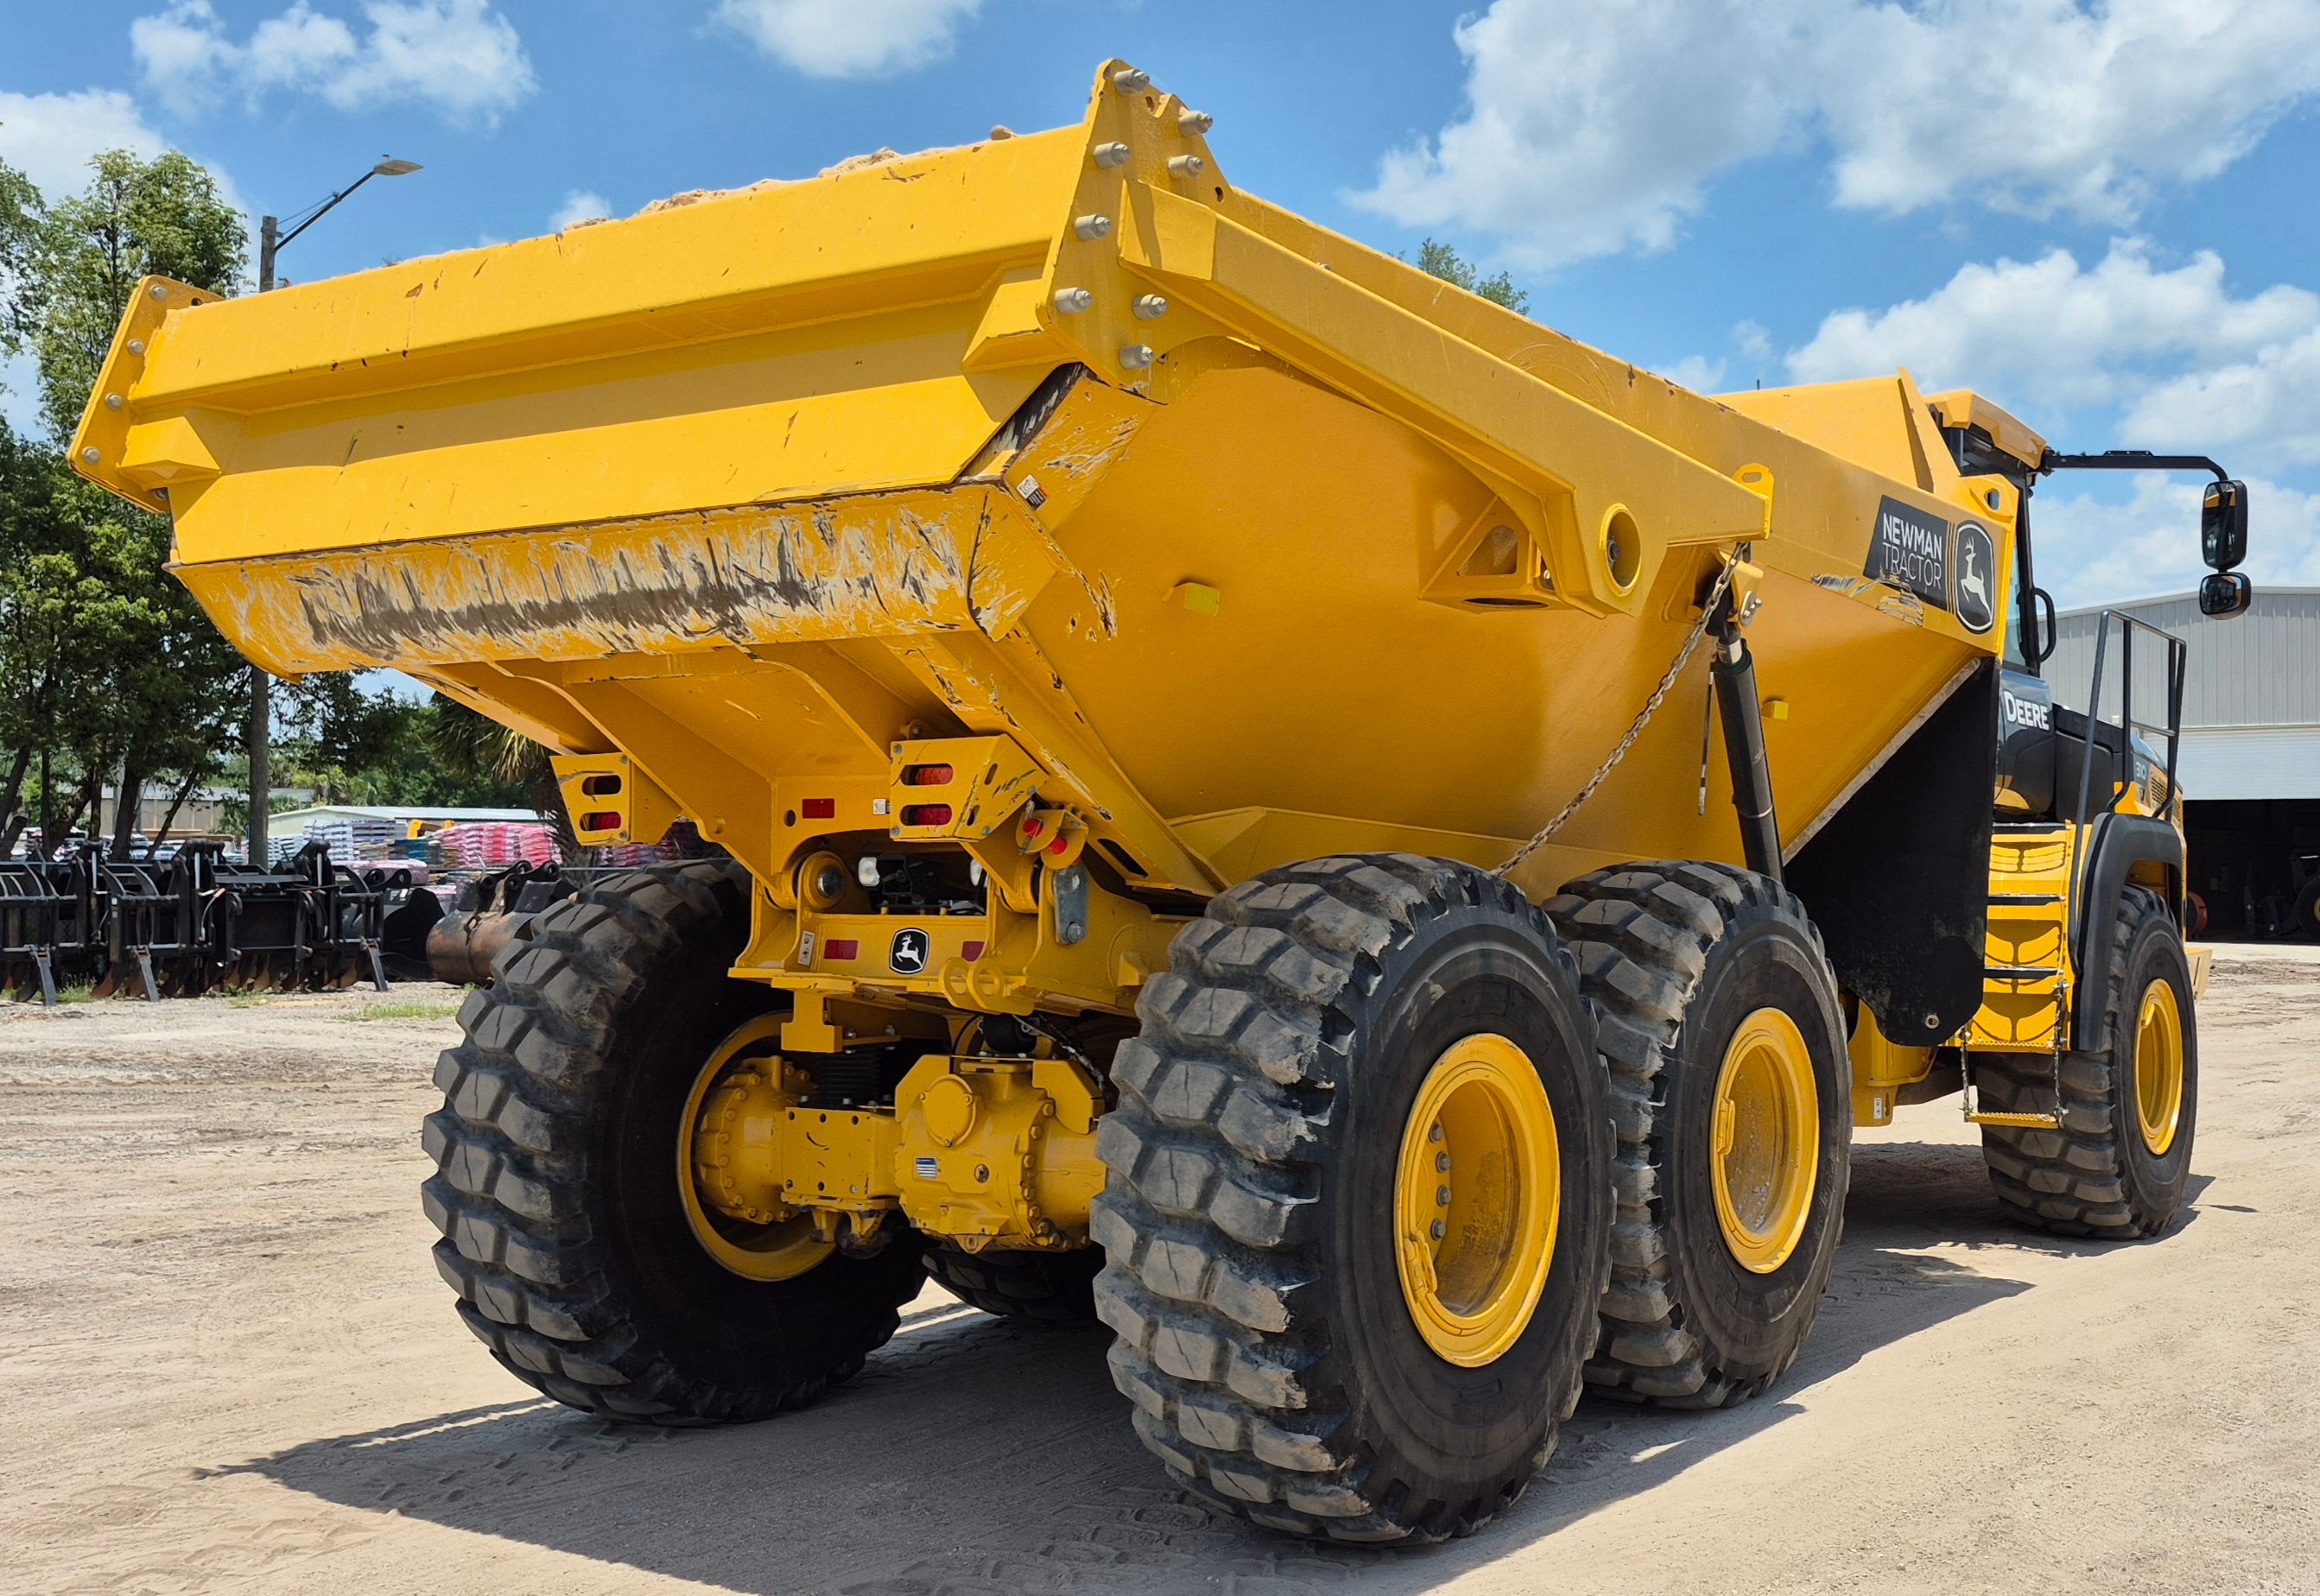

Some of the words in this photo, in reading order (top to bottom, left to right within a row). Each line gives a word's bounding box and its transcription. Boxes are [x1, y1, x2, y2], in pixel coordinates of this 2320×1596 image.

[1883, 512, 1943, 562] NEWMAN
[1882, 542, 1942, 590] TRACTOR
[2003, 690, 2050, 731] DEERE
